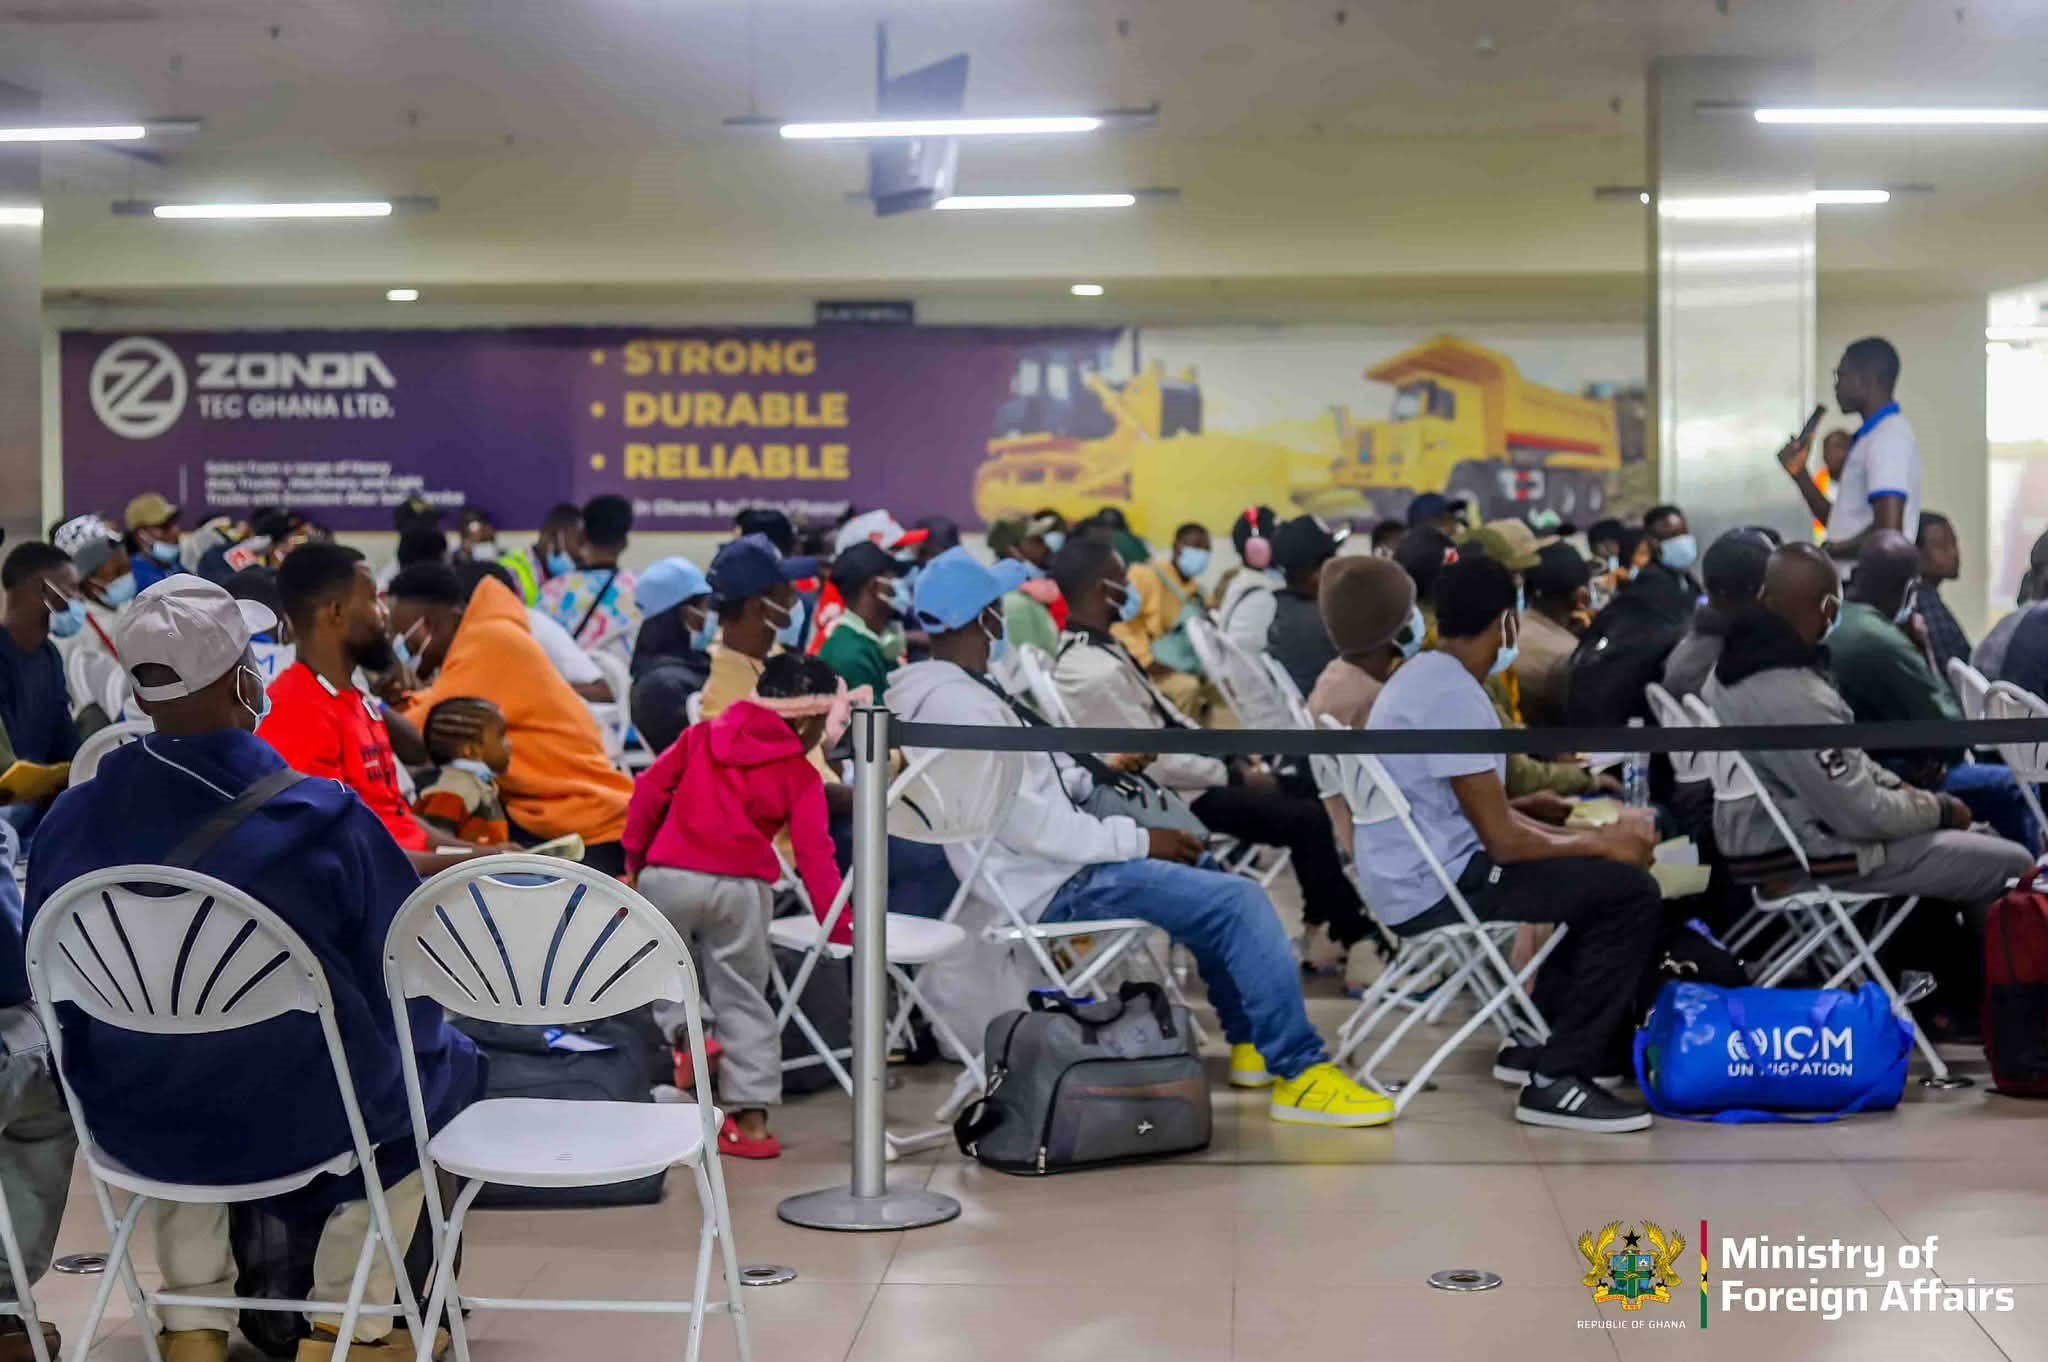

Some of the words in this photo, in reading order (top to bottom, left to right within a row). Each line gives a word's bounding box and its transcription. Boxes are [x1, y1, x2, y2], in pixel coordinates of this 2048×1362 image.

[196, 352, 396, 389] ZONDA
[624, 340, 817, 376] STRONG
[199, 394, 243, 418] TEC
[248, 394, 340, 418] GHANA
[624, 392, 849, 427] DURABLE
[624, 444, 850, 479] RELIABLE
[1772, 1026, 1853, 1061] IOM
[1727, 1063, 1754, 1077] UN
[1760, 1061, 1853, 1077] IGRATION
